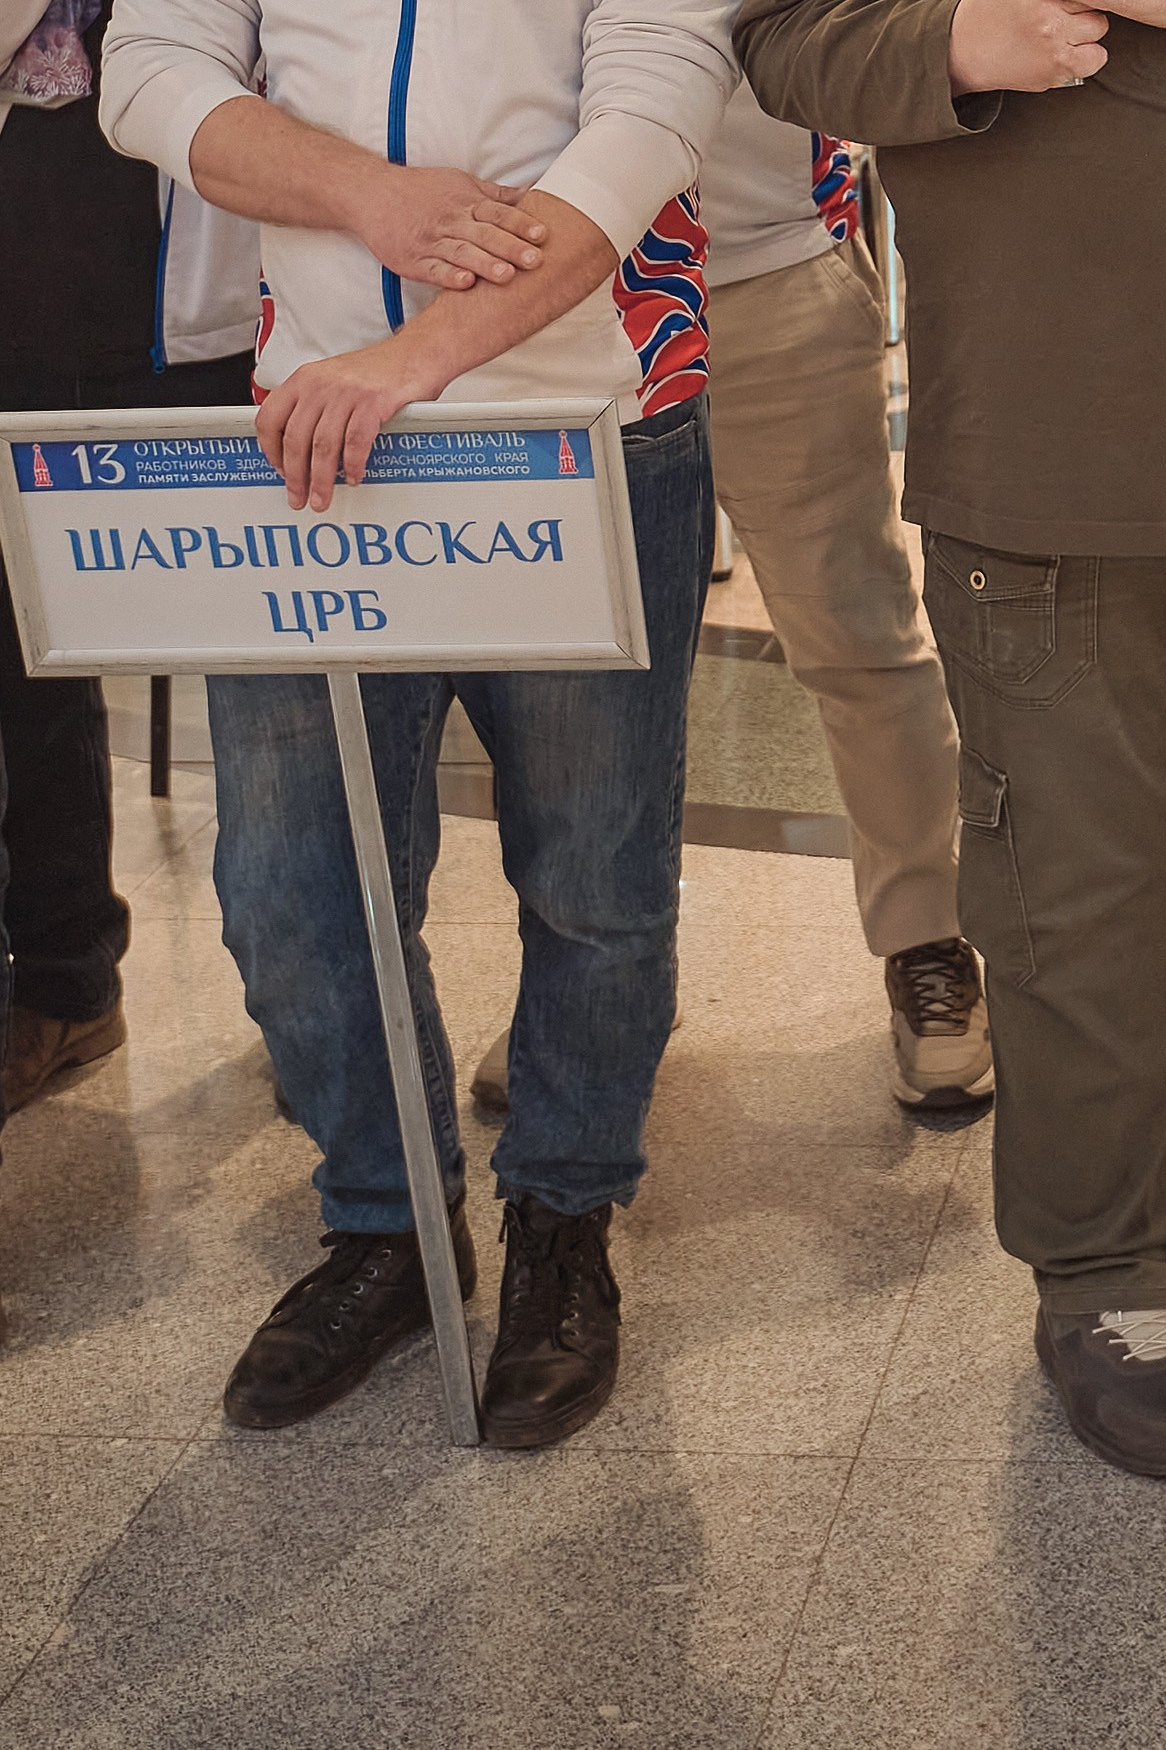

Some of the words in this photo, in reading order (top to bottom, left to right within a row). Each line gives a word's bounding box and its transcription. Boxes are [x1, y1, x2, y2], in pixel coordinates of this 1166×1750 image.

[134, 437, 250, 457] ОТКРЫТЫЙ
[399, 432, 526, 451] ФЕСТИВАЛЬ
[70, 443, 127, 484] 13
[136, 458, 227, 472] РАБОТНИКОВ
[374, 453, 486, 466] КРАСНОЯРСКОГО
[495, 452, 529, 463] КРАЯ
[138, 473, 190, 484] ПАМЯТИ
[192, 471, 278, 482] ЗАСЛУЖЕННОГ
[364, 466, 417, 478] ЛЬБЕРТА
[419, 465, 531, 477] КРЫЖАНОВСКОГО
[64, 519, 564, 572] ШАРЫПОВСКАЯ
[263, 589, 389, 643] ЦРБ
